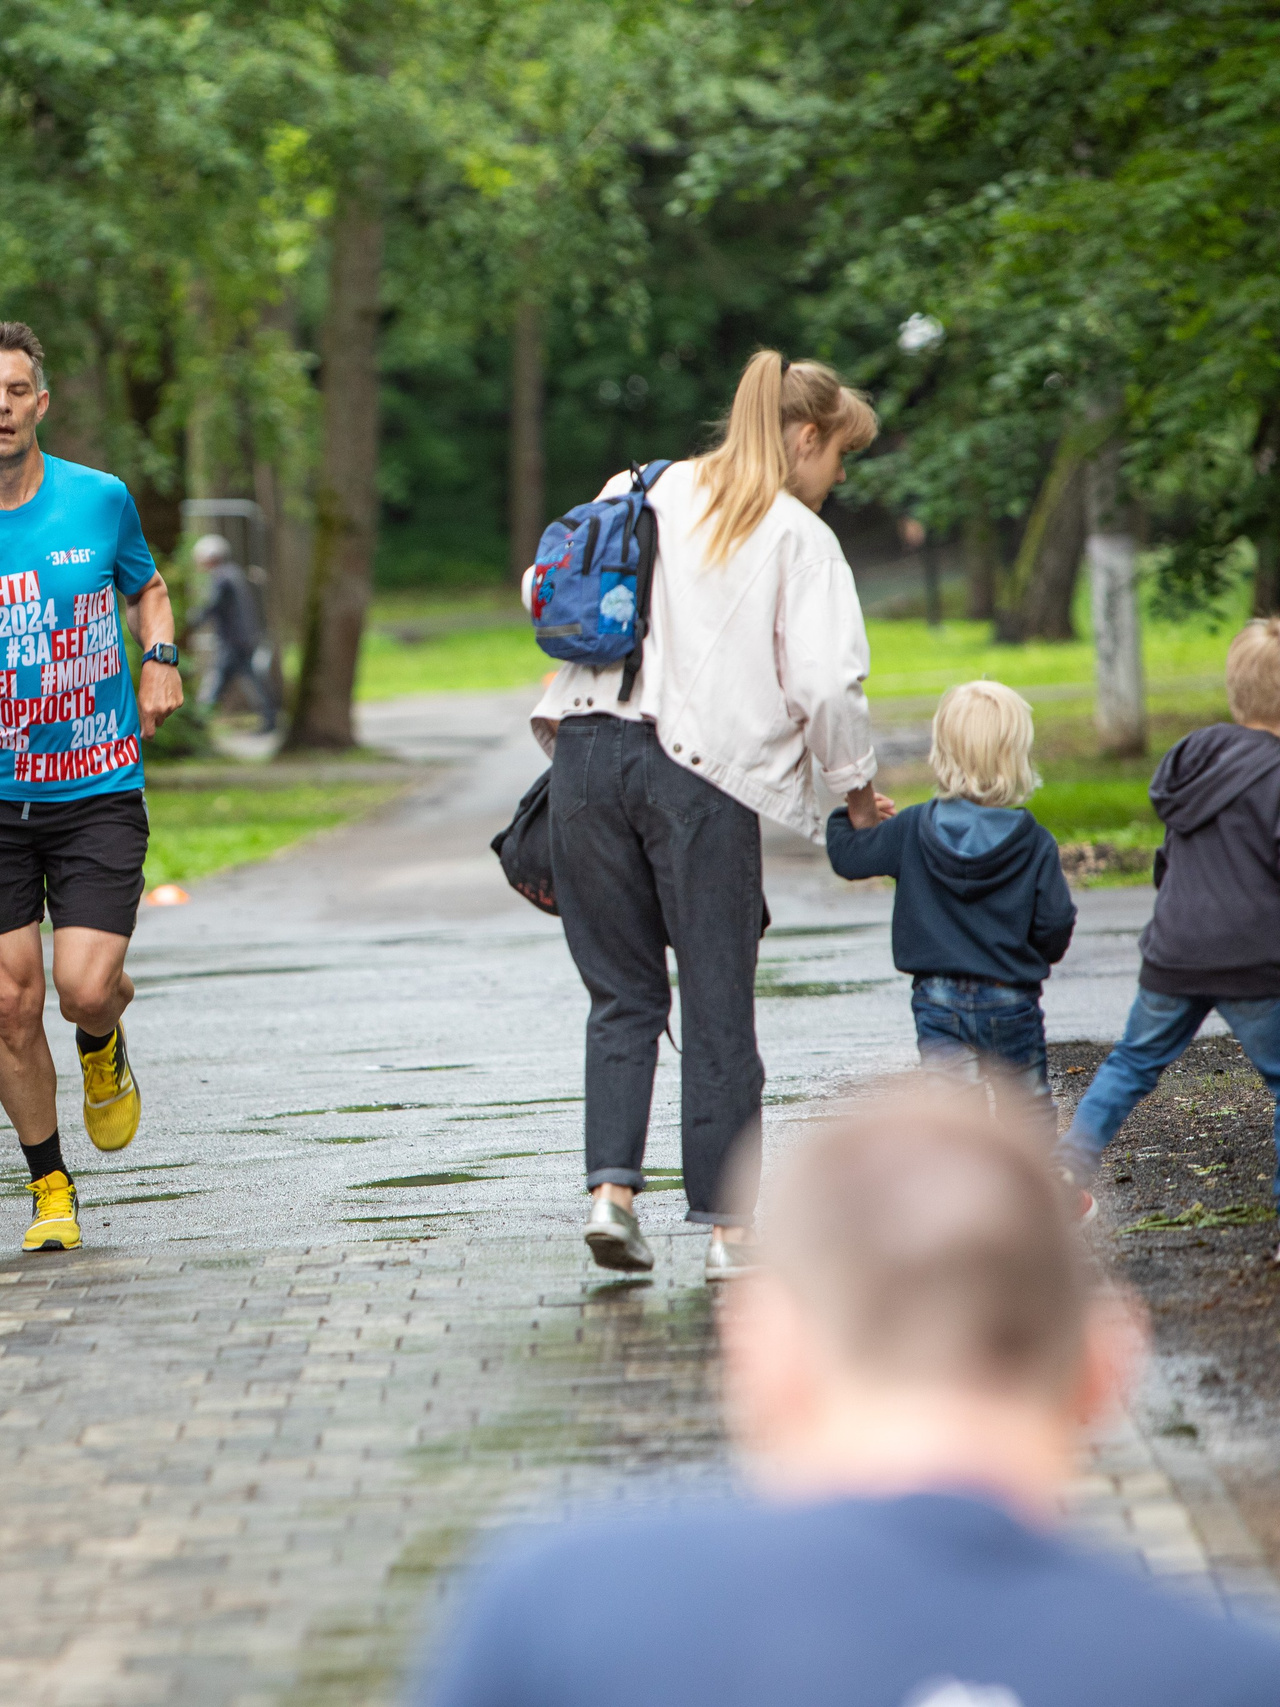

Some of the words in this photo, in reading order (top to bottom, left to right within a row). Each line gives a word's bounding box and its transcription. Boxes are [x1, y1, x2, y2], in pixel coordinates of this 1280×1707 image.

[7, 610, 118, 668] #ЗАБЕГ2024
[41, 643, 121, 695] #МОМЕНТ
[71, 709, 118, 749] 2024
[15, 734, 140, 782] #ЕДИНСТВО
